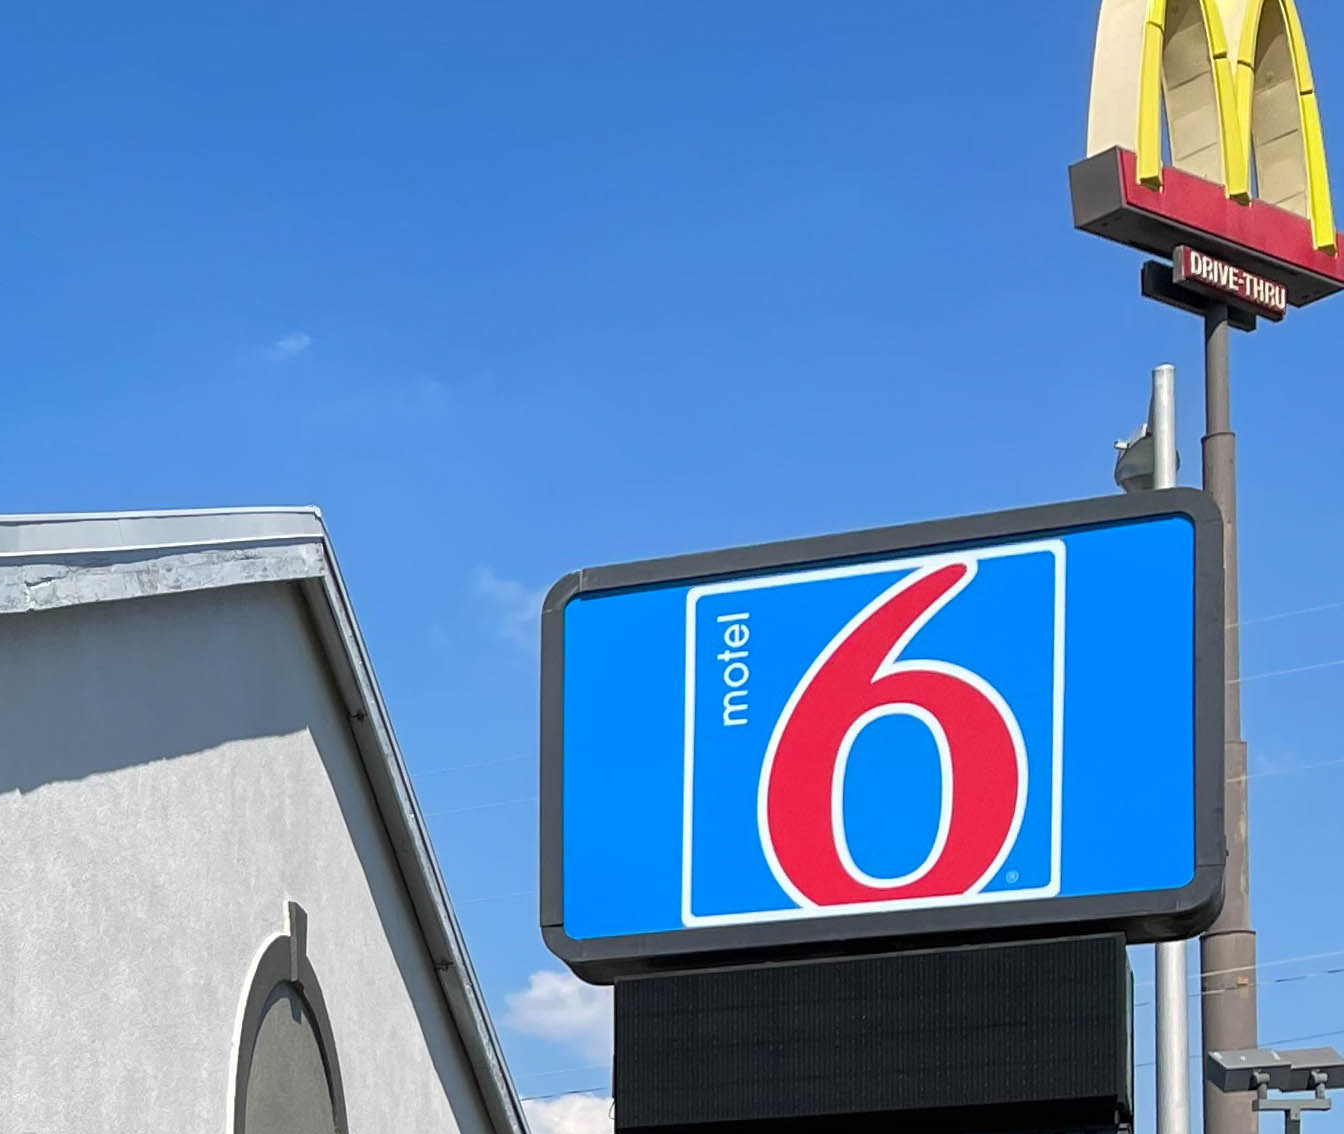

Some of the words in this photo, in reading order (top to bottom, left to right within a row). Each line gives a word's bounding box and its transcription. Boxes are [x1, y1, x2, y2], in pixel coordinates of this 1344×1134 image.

[1191, 250, 1286, 309] DRIVE-THRU
[717, 612, 750, 727] motel
[757, 556, 1028, 908] 6
